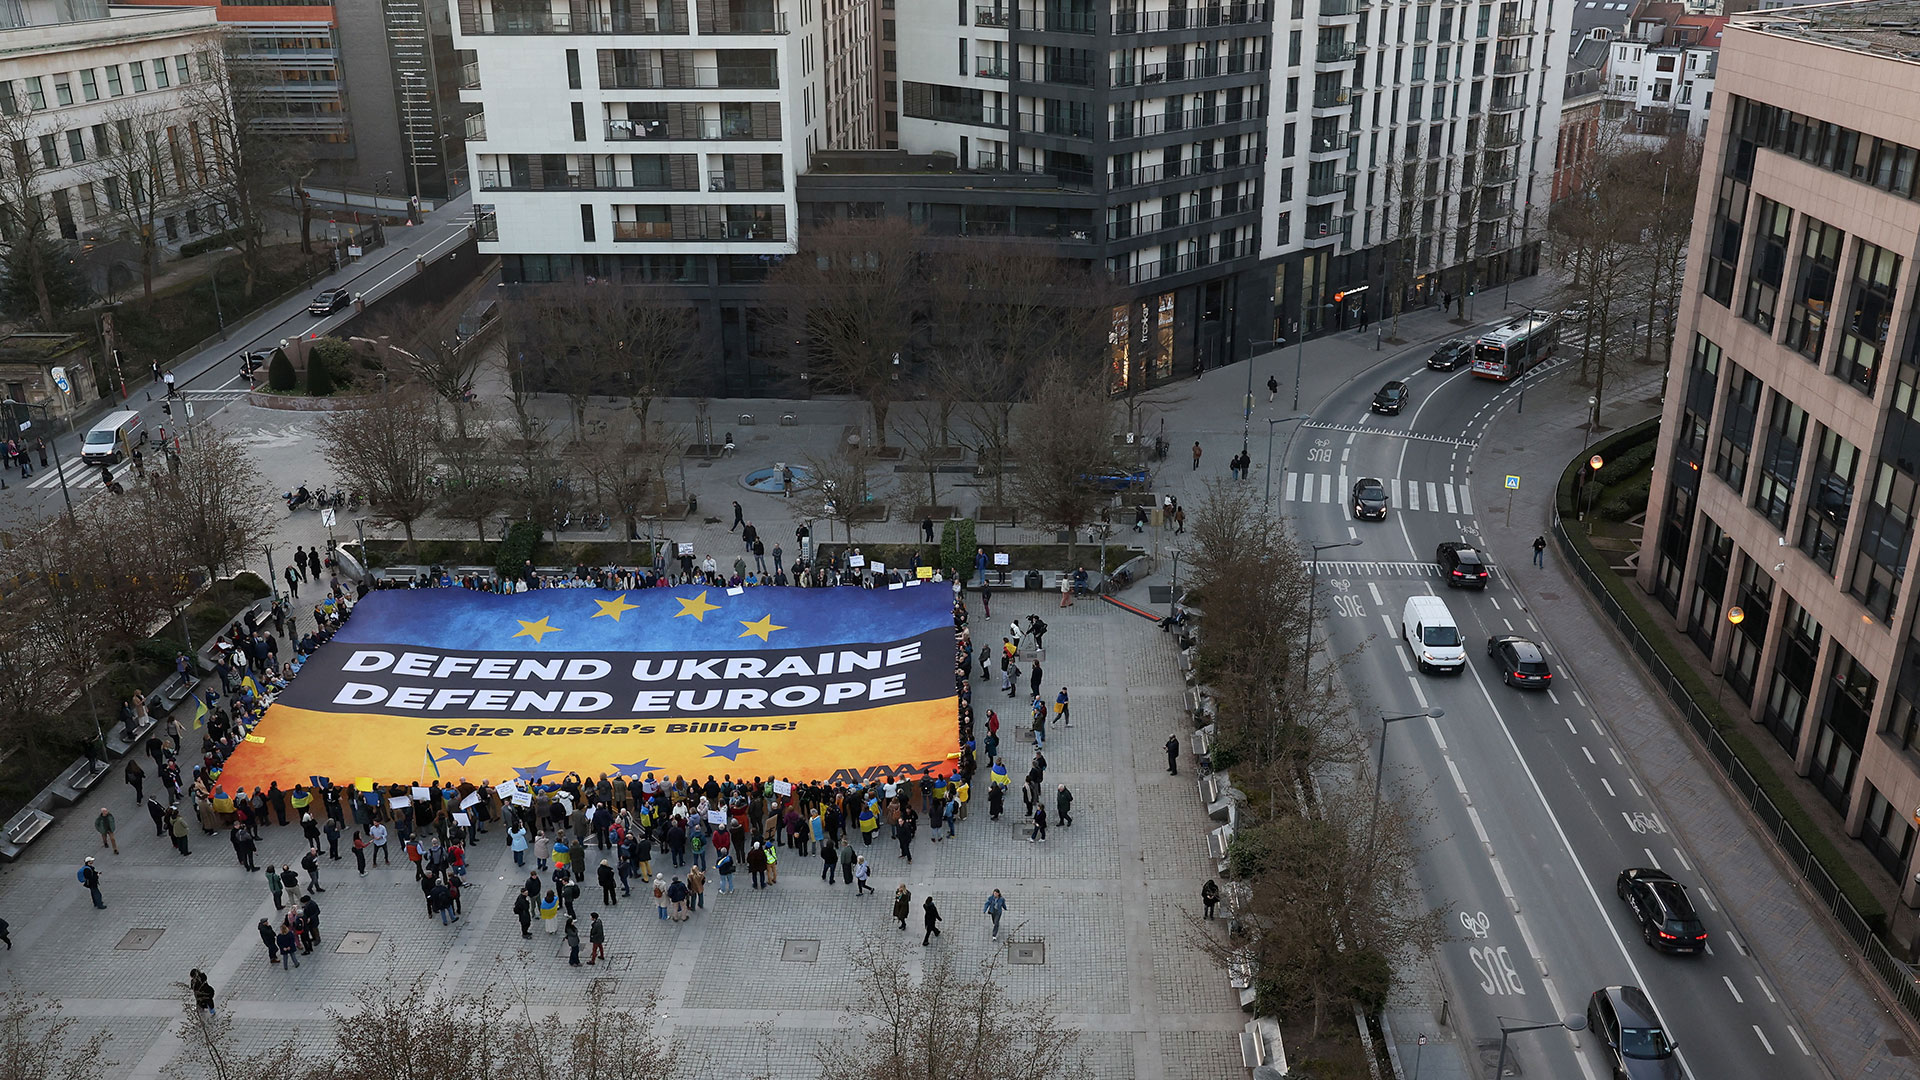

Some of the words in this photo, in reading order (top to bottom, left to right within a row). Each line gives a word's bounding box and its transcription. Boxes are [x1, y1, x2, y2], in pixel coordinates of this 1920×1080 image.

[1307, 448, 1332, 462] BUS
[1333, 595, 1367, 617] BUS
[341, 650, 612, 680] DEFEND
[631, 641, 922, 681] UKRAINE
[332, 682, 613, 712] DEFEND
[631, 673, 907, 712] EUROPE
[426, 724, 514, 737] Seize
[665, 721, 798, 734] Billions!
[828, 760, 944, 785] AVAAZ
[1469, 946, 1526, 995] BUS
